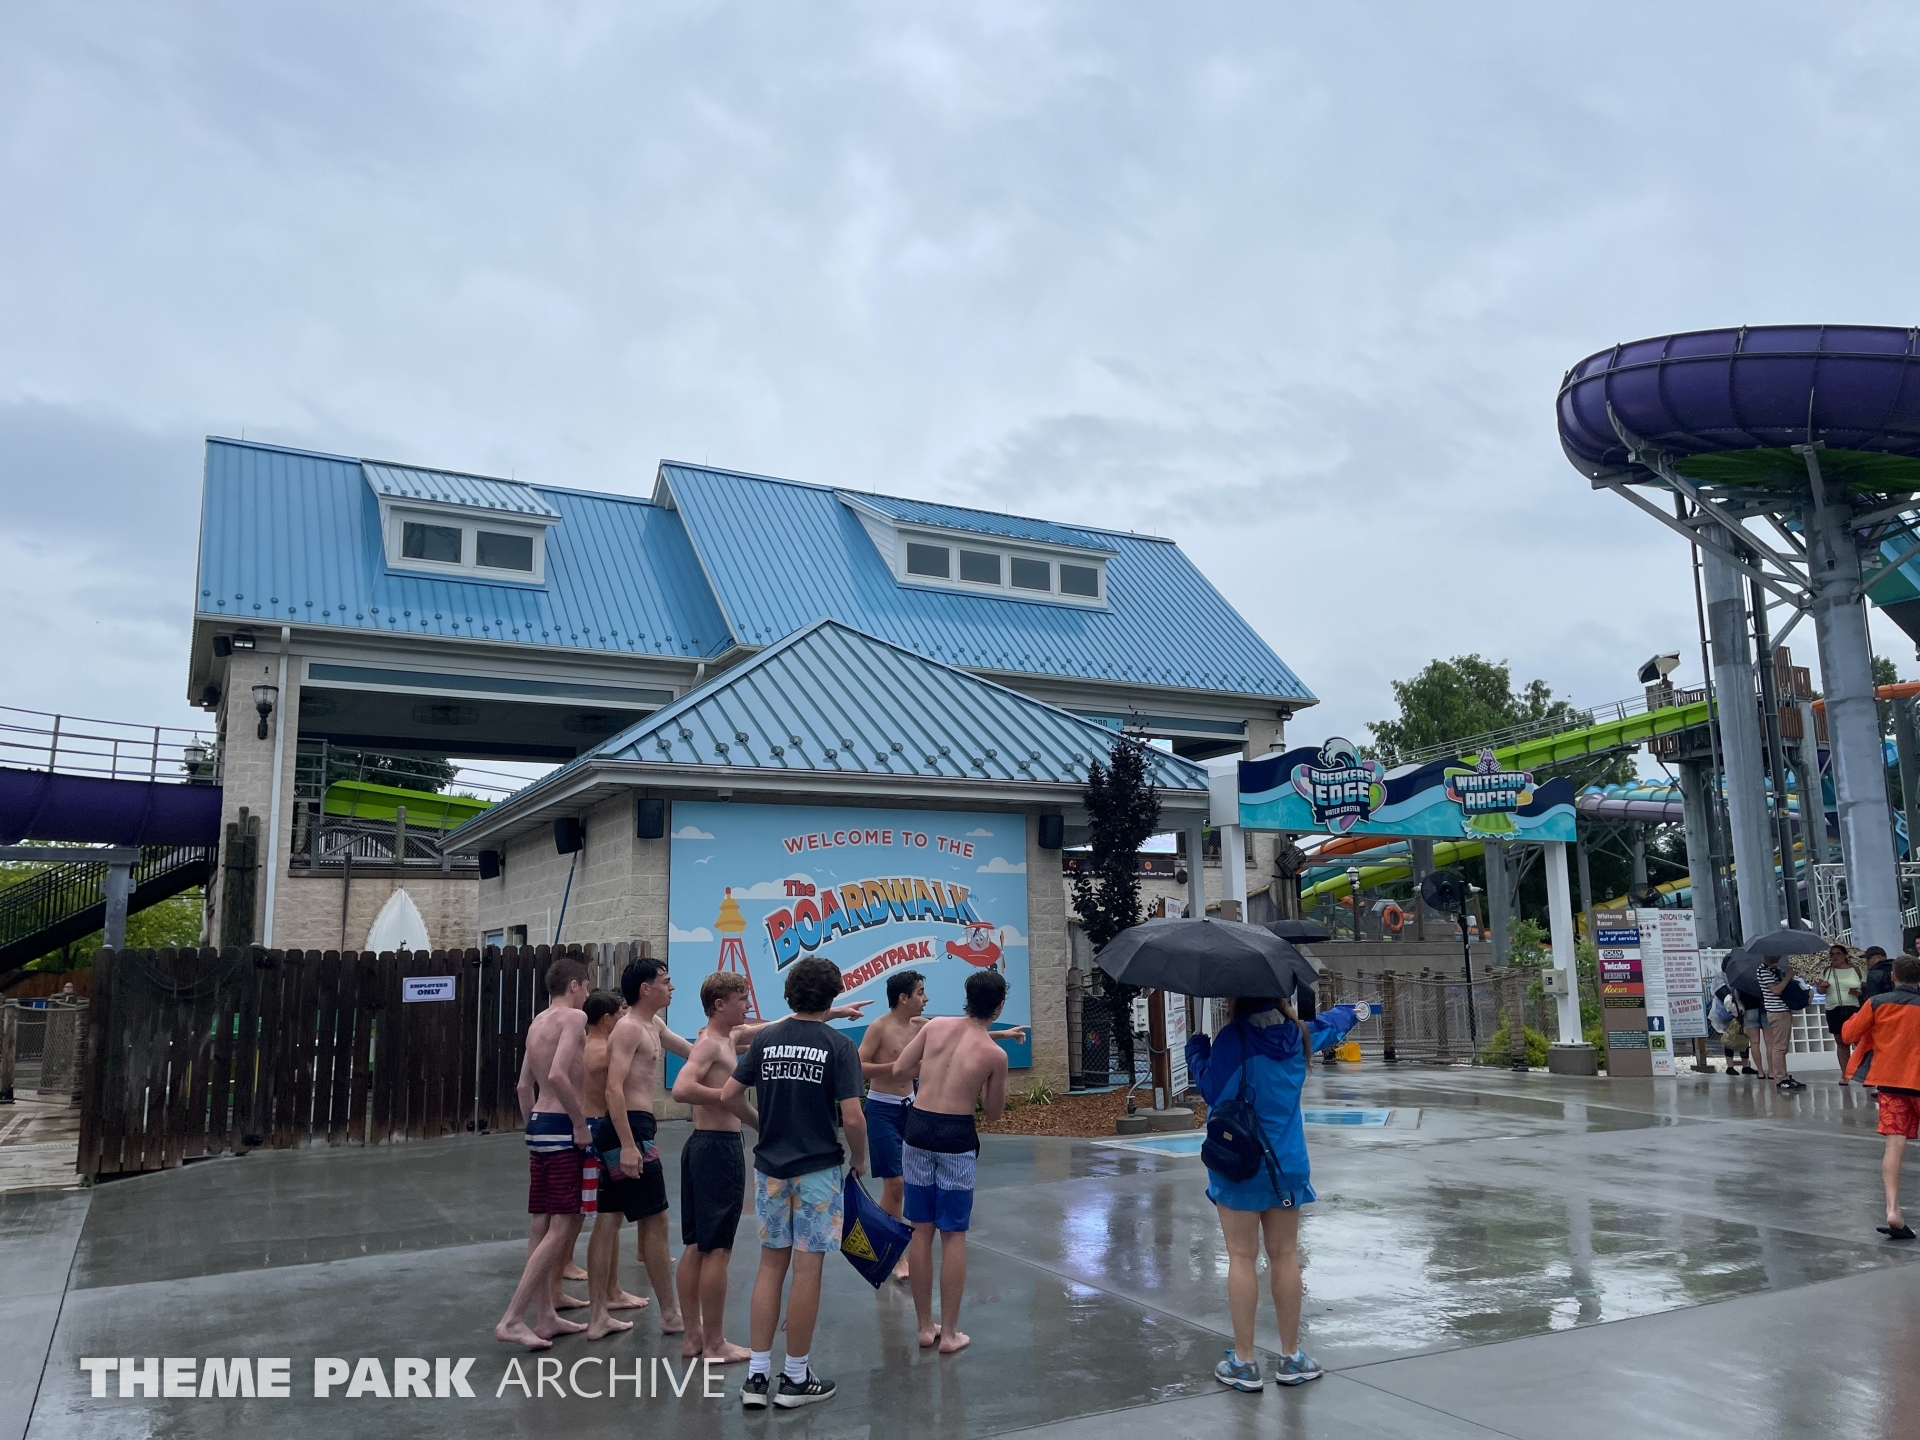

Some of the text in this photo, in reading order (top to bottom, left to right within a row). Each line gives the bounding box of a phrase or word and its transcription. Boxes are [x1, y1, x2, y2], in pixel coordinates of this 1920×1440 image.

[1311, 769, 1372, 784] BREAKERS
[1455, 773, 1525, 790] WHITECAP
[1315, 781, 1370, 806] EDGE
[1465, 790, 1517, 809] RACER
[1325, 805, 1361, 816] WATER COASTER
[783, 829, 975, 859] WELCOME TO THE
[784, 880, 816, 897] The
[765, 877, 981, 970] BOARDWALK
[839, 940, 933, 993] RSHEYPARK
[1603, 971, 1631, 980] HERSHEY'S
[417, 988, 441, 996] ONLY
[1673, 997, 1698, 1007] SWIMMING
[1678, 1003, 1702, 1014] REQUIRED
[763, 1045, 829, 1063] TRADITION
[761, 1060, 824, 1084] STRONG
